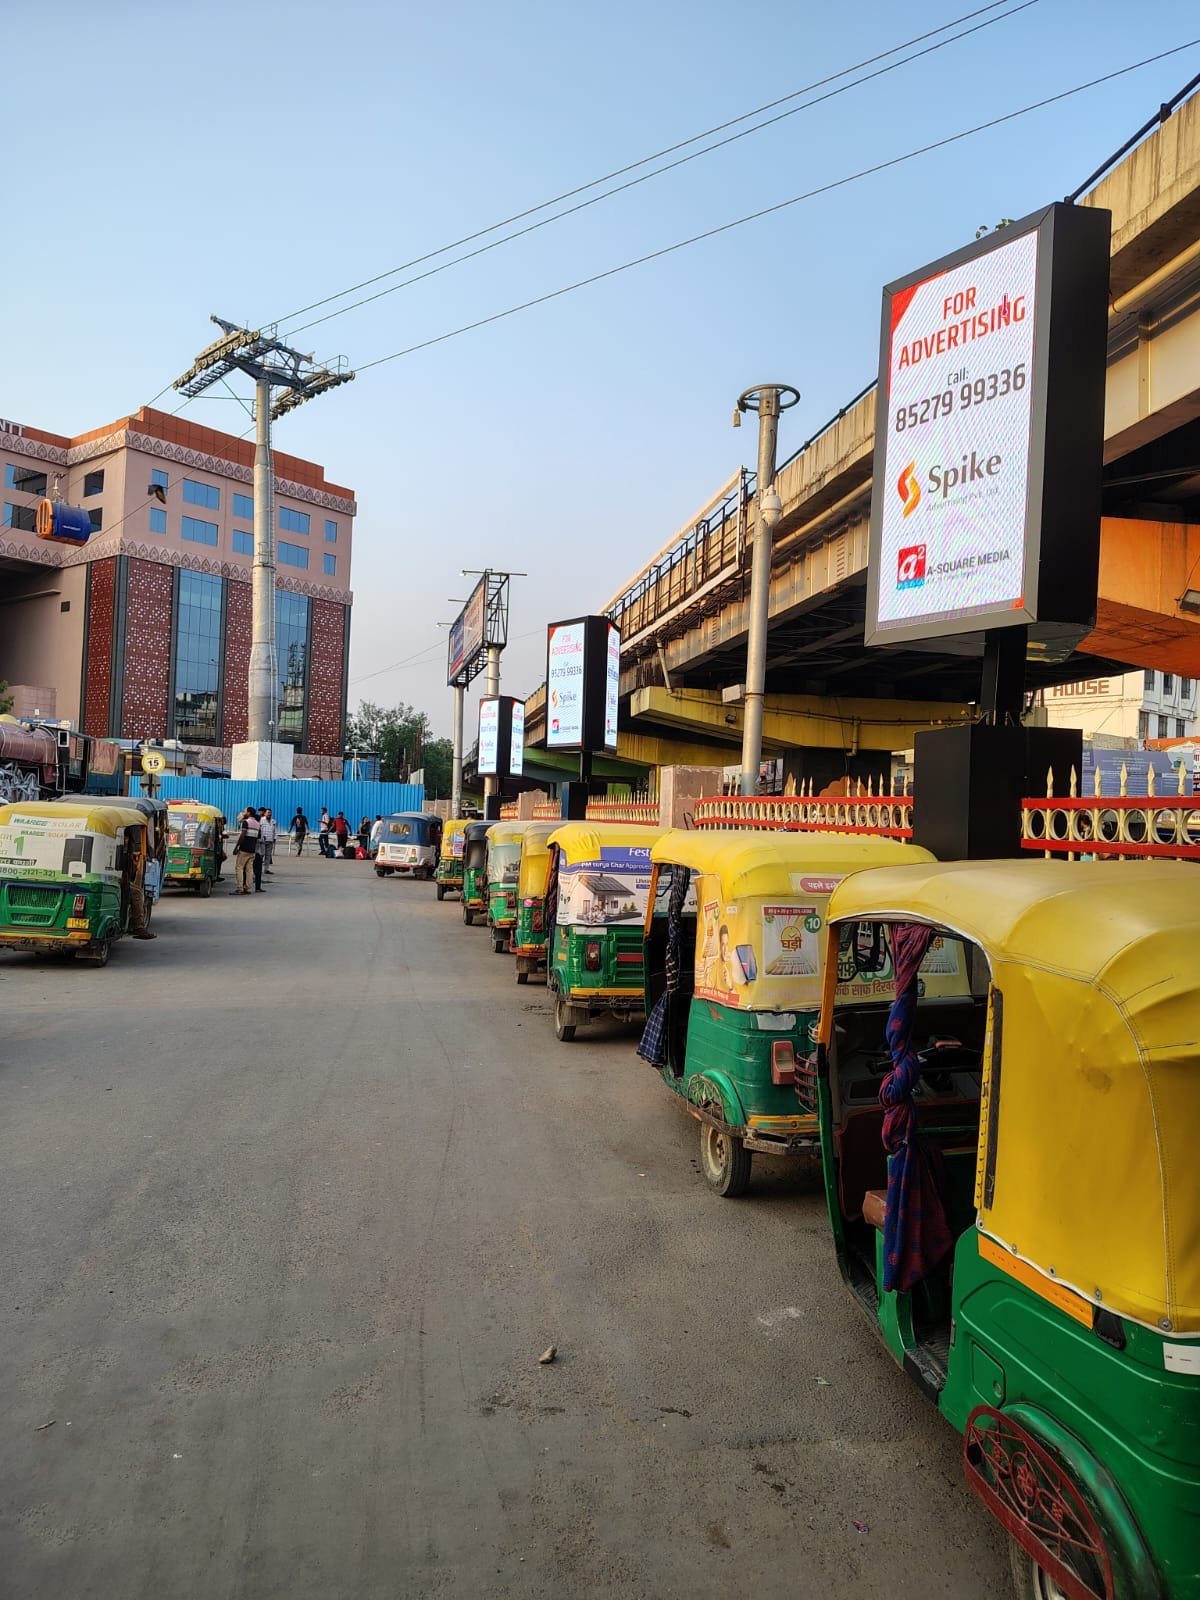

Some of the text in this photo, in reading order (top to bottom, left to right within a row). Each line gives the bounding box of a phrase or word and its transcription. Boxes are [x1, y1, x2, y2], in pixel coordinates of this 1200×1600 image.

[943, 286, 977, 320] FOR
[898, 295, 1026, 370] ADVERTISING
[895, 362, 1026, 433] 85279 99336
[928, 451, 1002, 498] Spike
[926, 556, 976, 576] A-SQUARE
[977, 549, 1010, 567] MEDIA
[1053, 679, 1110, 697] HOUSE
[147, 759, 159, 767] 15
